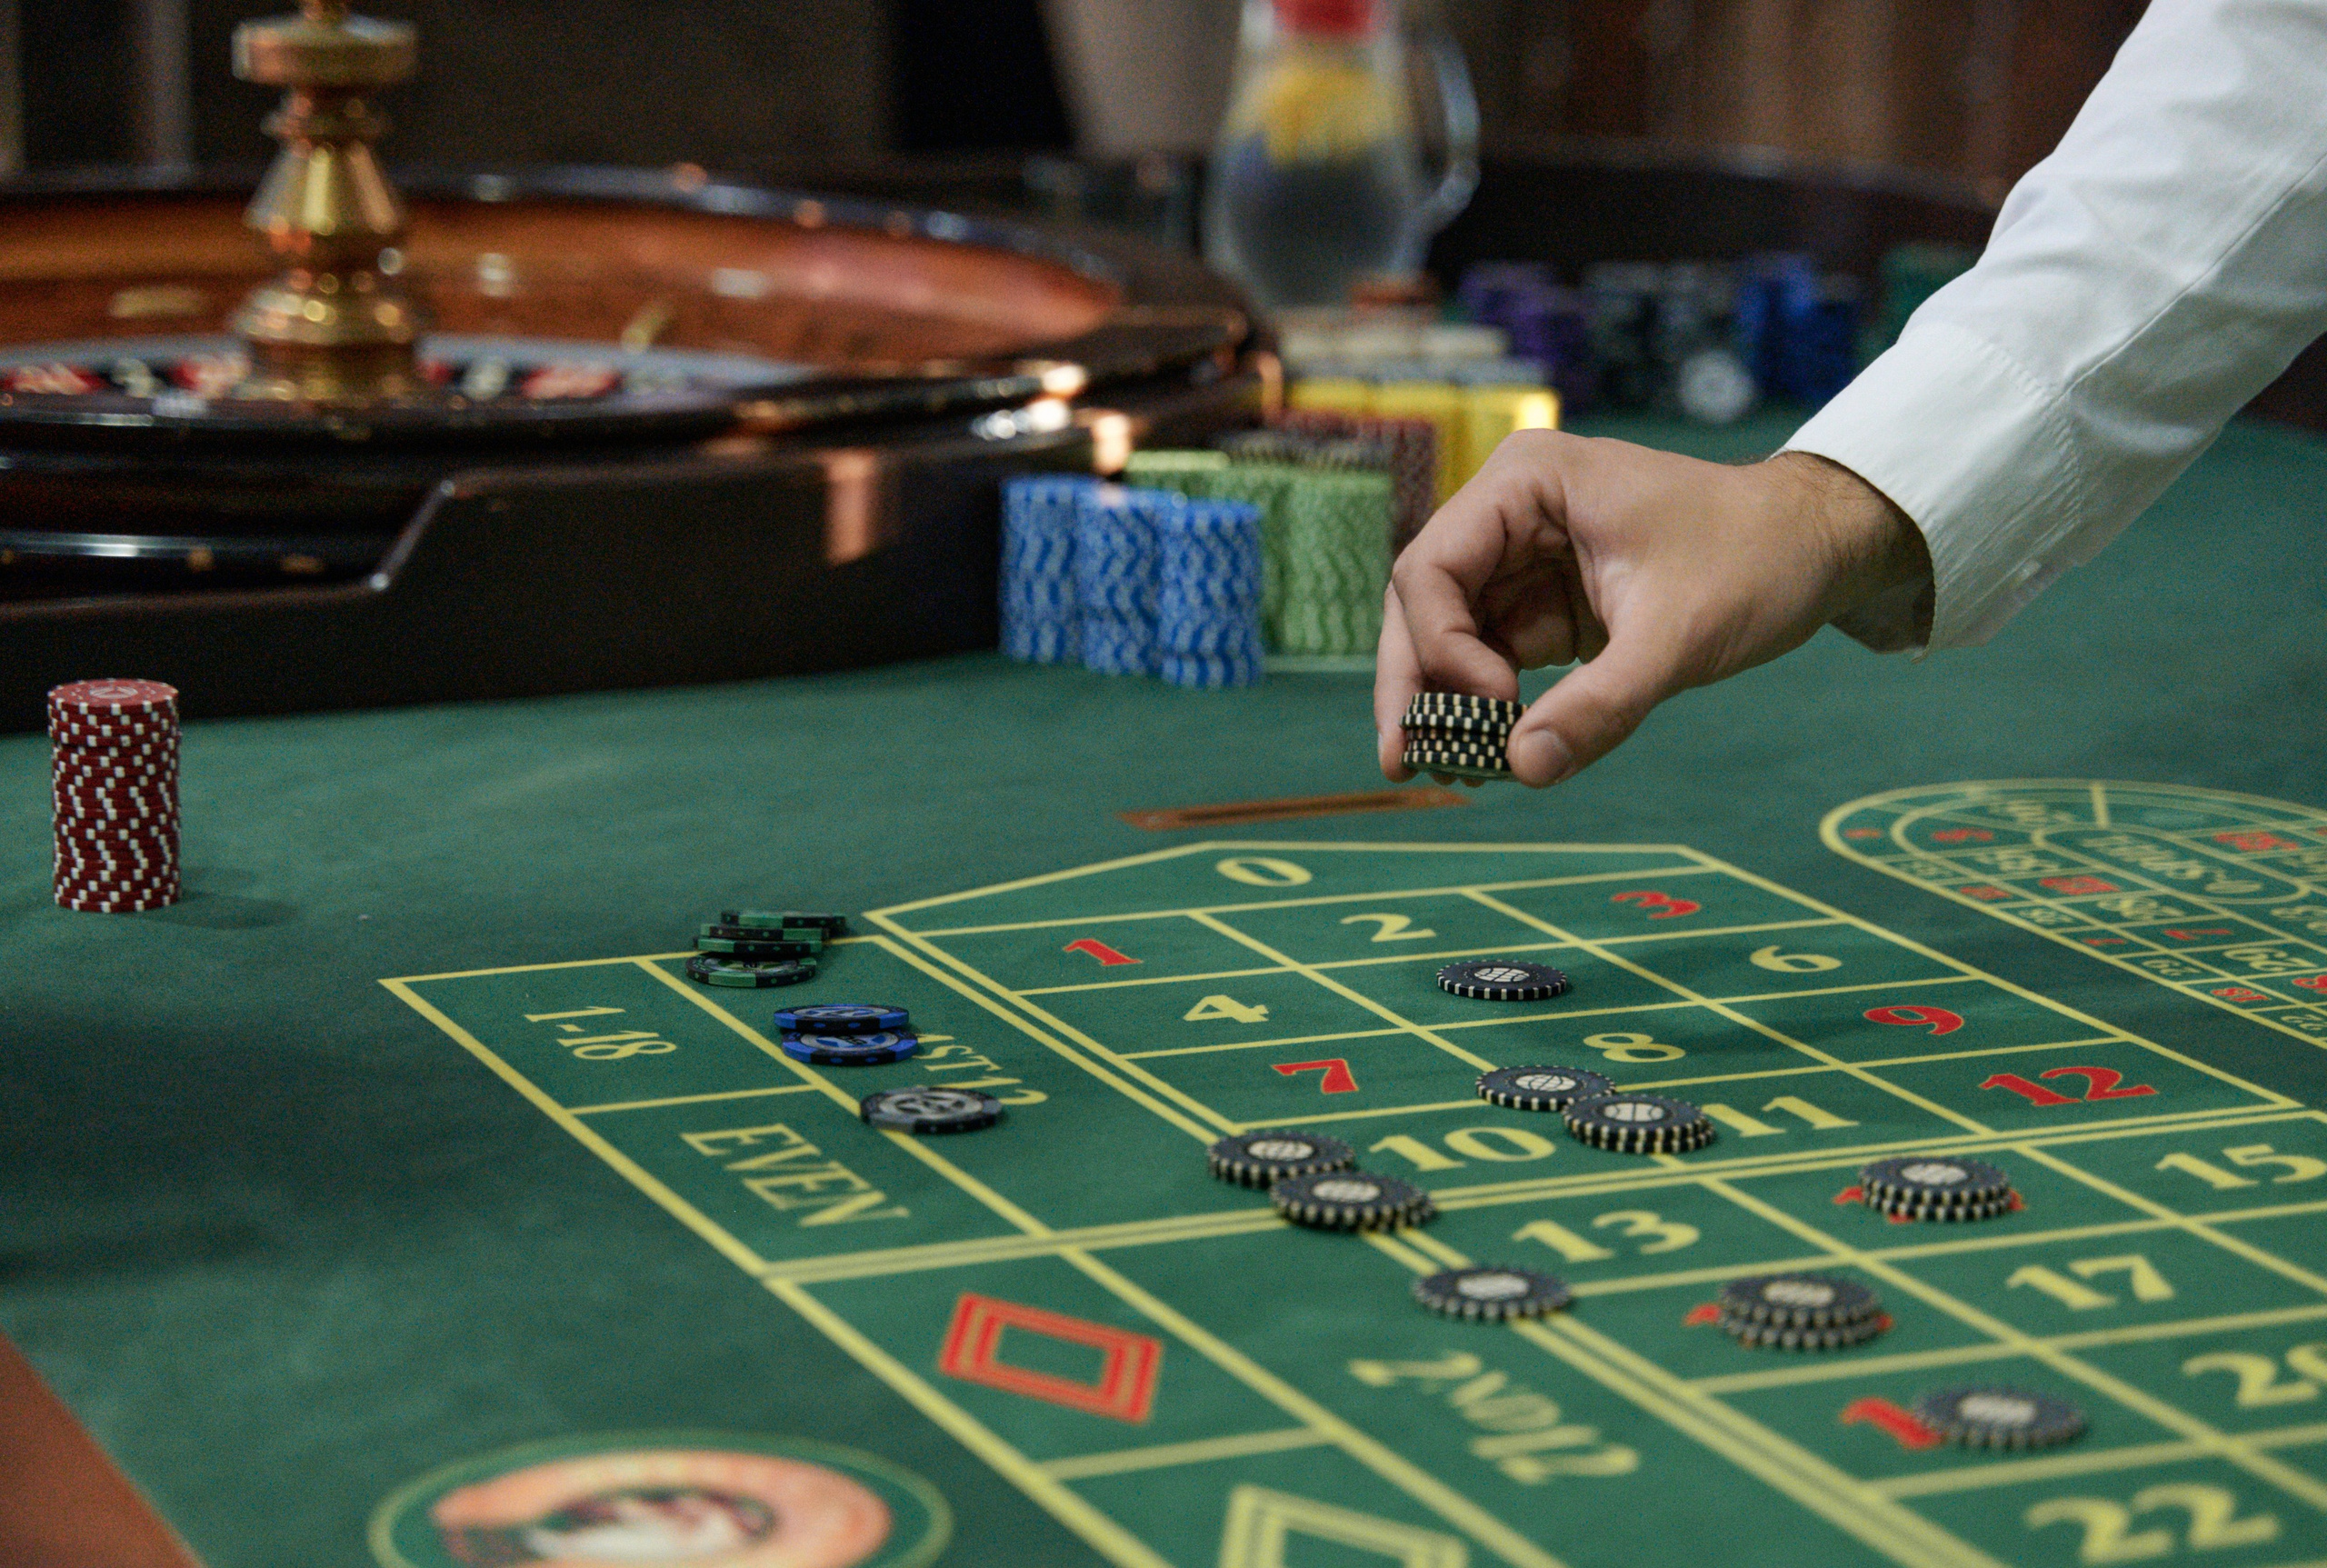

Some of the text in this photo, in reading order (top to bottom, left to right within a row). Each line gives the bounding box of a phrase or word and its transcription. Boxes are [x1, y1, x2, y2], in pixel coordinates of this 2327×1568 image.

[1216, 857, 1313, 887] 0
[1612, 890, 1701, 920] 3
[1341, 912, 1437, 943] 2
[1064, 937, 1142, 967] 1
[1749, 944, 1843, 974] 6
[1183, 994, 1270, 1024] 4
[1863, 1004, 1964, 1036] 9
[524, 1005, 678, 1061] 1-18
[1583, 1032, 1687, 1064] 8
[1272, 1057, 1359, 1094] 7
[1978, 1065, 2160, 1107] 12
[1702, 1094, 1861, 1138] 11
[1369, 1126, 1556, 1172] 10
[2153, 1143, 2327, 1190] 15
[679, 1122, 910, 1228] EVEN
[1513, 1210, 1700, 1263] 13
[2006, 1253, 2174, 1310] 17
[2025, 1482, 2282, 1564] 22
